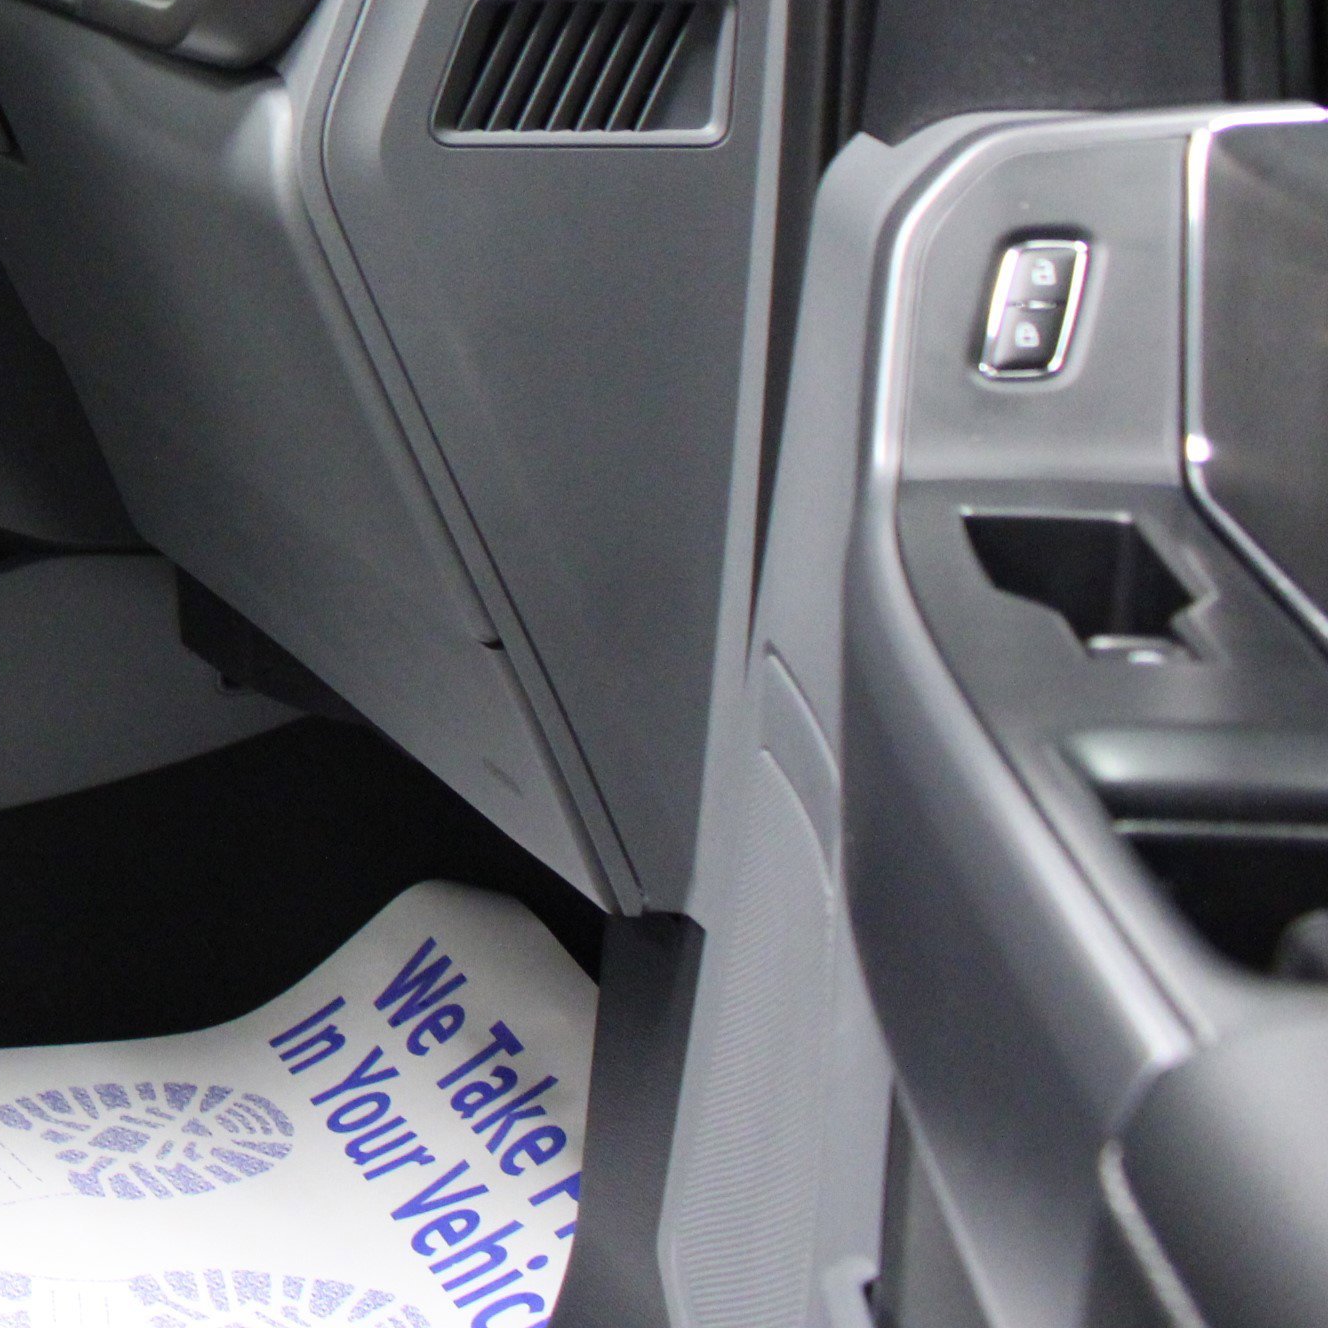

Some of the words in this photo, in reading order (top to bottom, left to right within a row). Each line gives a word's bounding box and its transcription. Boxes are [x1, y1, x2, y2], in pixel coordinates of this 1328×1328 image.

[269, 996, 346, 1075] In
[310, 1045, 436, 1181] Your
[390, 1159, 552, 1328] Vehic
[373, 936, 467, 1056] We
[436, 1020, 567, 1176] Take
